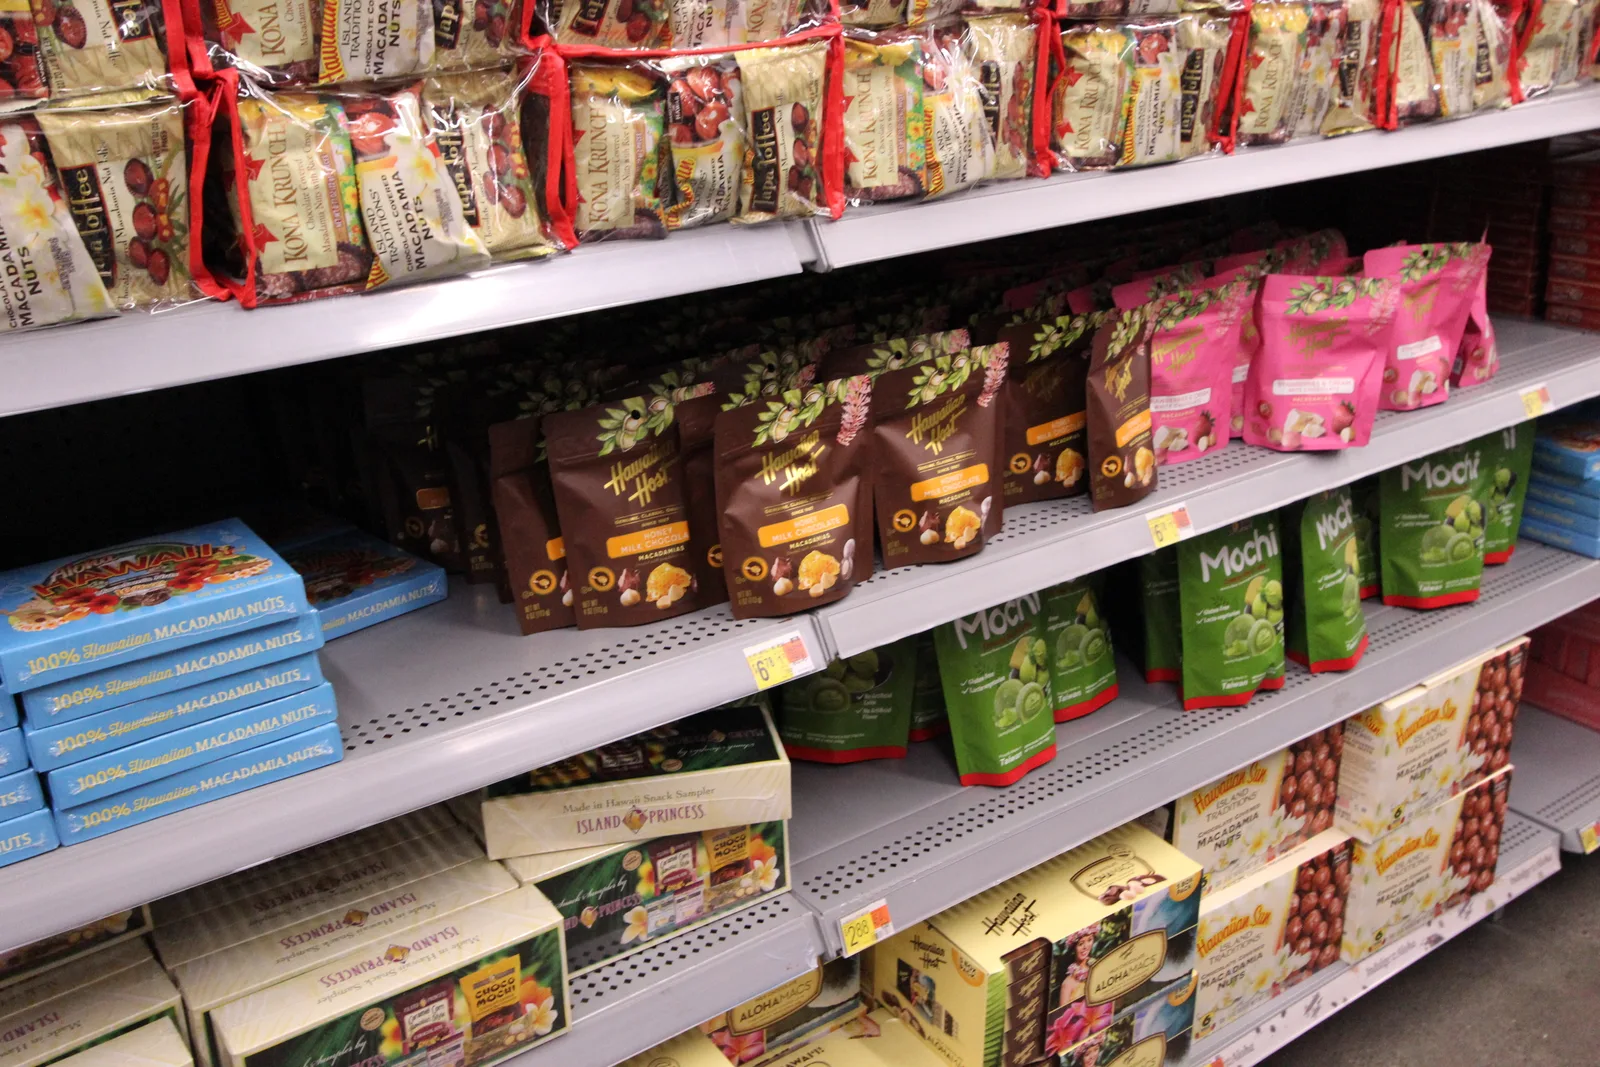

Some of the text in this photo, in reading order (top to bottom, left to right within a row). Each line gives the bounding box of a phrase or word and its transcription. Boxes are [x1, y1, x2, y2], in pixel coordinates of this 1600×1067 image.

[259, 3, 287, 57] KONA
[1181, 51, 1202, 134] Tapa Toffee
[1253, 94, 1272, 129] KONA
[856, 71, 880, 180] KONA KRUNCH
[1074, 115, 1093, 151] KONA
[1149, 79, 1161, 156] MACADAMIA
[1157, 100, 1167, 134] NUTS
[751, 110, 777, 206] Tapa Toffee
[69, 168, 107, 237] Toffee
[266, 126, 310, 263] KONA KRUNCH
[300, 191, 316, 230] Chocolate
[587, 180, 609, 223] KONA
[366, 207, 388, 256] ISLAND
[380, 174, 414, 272] CHOCOLATE COVERED
[390, 170, 427, 271] MACADAMIA
[412, 195, 434, 241] NUTS
[16, 245, 43, 295] NUTS
[906, 394, 965, 445] Hawaiian
[925, 407, 967, 456] Host
[754, 430, 820, 485] Hawaiian
[779, 445, 826, 496] Host
[1402, 451, 1481, 492] Mochi
[628, 455, 680, 508] Host
[620, 542, 643, 554] MILK
[644, 527, 674, 540] HONEY
[771, 517, 841, 543] MILK CHOCOLATE
[789, 533, 831, 549] MACADAMIAS
[31, 543, 215, 598] HAWAII
[50, 553, 117, 581] Aloha
[638, 545, 685, 561] MACADAMIAS
[1199, 522, 1280, 584] Mochi
[347, 584, 436, 623] MACADAMIA NUTS
[27, 595, 285, 676] 100% Hawaiian MACADAMIA NUTS
[51, 629, 302, 716] 100% Hawaiian MACADAMIA NUTS
[1221, 679, 1249, 690] Taiwan
[56, 668, 301, 756] 100% Hawaiian MACADAMIA NUTS
[1395, 708, 1441, 748] Hawaiian
[76, 703, 317, 793] 100% Hawaiian MACADAMIA NUTS
[999, 751, 1024, 767] Taiwan
[1395, 748, 1448, 781] MACADAMIA
[82, 744, 323, 830] 100% Hawaiian MACADAMIA NUTS
[1192, 761, 1268, 815] Hawaiian Sun
[1409, 765, 1433, 783] NUTS
[562, 786, 717, 814] Made in Hawaii Snack Sampler
[1205, 789, 1258, 823] TRADITIONS
[1215, 787, 1249, 810] ISLAND
[1393, 807, 1402, 819] 6
[576, 804, 706, 835] ISLAND PRINCESS
[1196, 812, 1259, 850] MACADAMIA
[1197, 803, 1261, 839] CHOCOLATE COVERED
[713, 833, 747, 851] CHOCO
[1213, 830, 1242, 852] NUTS
[1375, 836, 1422, 876] Hawaiian
[598, 893, 643, 918] PRINCESS
[1375, 873, 1430, 907] MACADAMIA
[1389, 891, 1415, 908] NUTS
[279, 892, 418, 949] ISLAND PRINCESS
[982, 892, 1028, 937] Hawaiian
[1009, 898, 1038, 937] Host
[1196, 904, 1272, 959] Hawaiian Sun
[275, 945, 321, 965] Sampler
[318, 926, 460, 988] ISLAND PRINCESS
[909, 934, 946, 957] Hawaiian
[918, 952, 948, 970] Host
[1209, 932, 1263, 965] TRADITIONS
[1218, 931, 1253, 952] ISLAND
[366, 969, 398, 985] Snack
[1094, 953, 1158, 994] ALOHAMACS
[1200, 943, 1265, 980] CHOCOLATE COVERED
[1200, 951, 1263, 990] MACADAMIA
[1216, 970, 1246, 992] NUTS
[316, 983, 363, 1005] Sampler
[474, 977, 516, 1000] CHOCO
[476, 985, 517, 1007] MOCHI
[739, 979, 813, 1024] ALOHAMACS
[2, 1012, 61, 1042] ISLAND
[1201, 1014, 1212, 1027] 6
